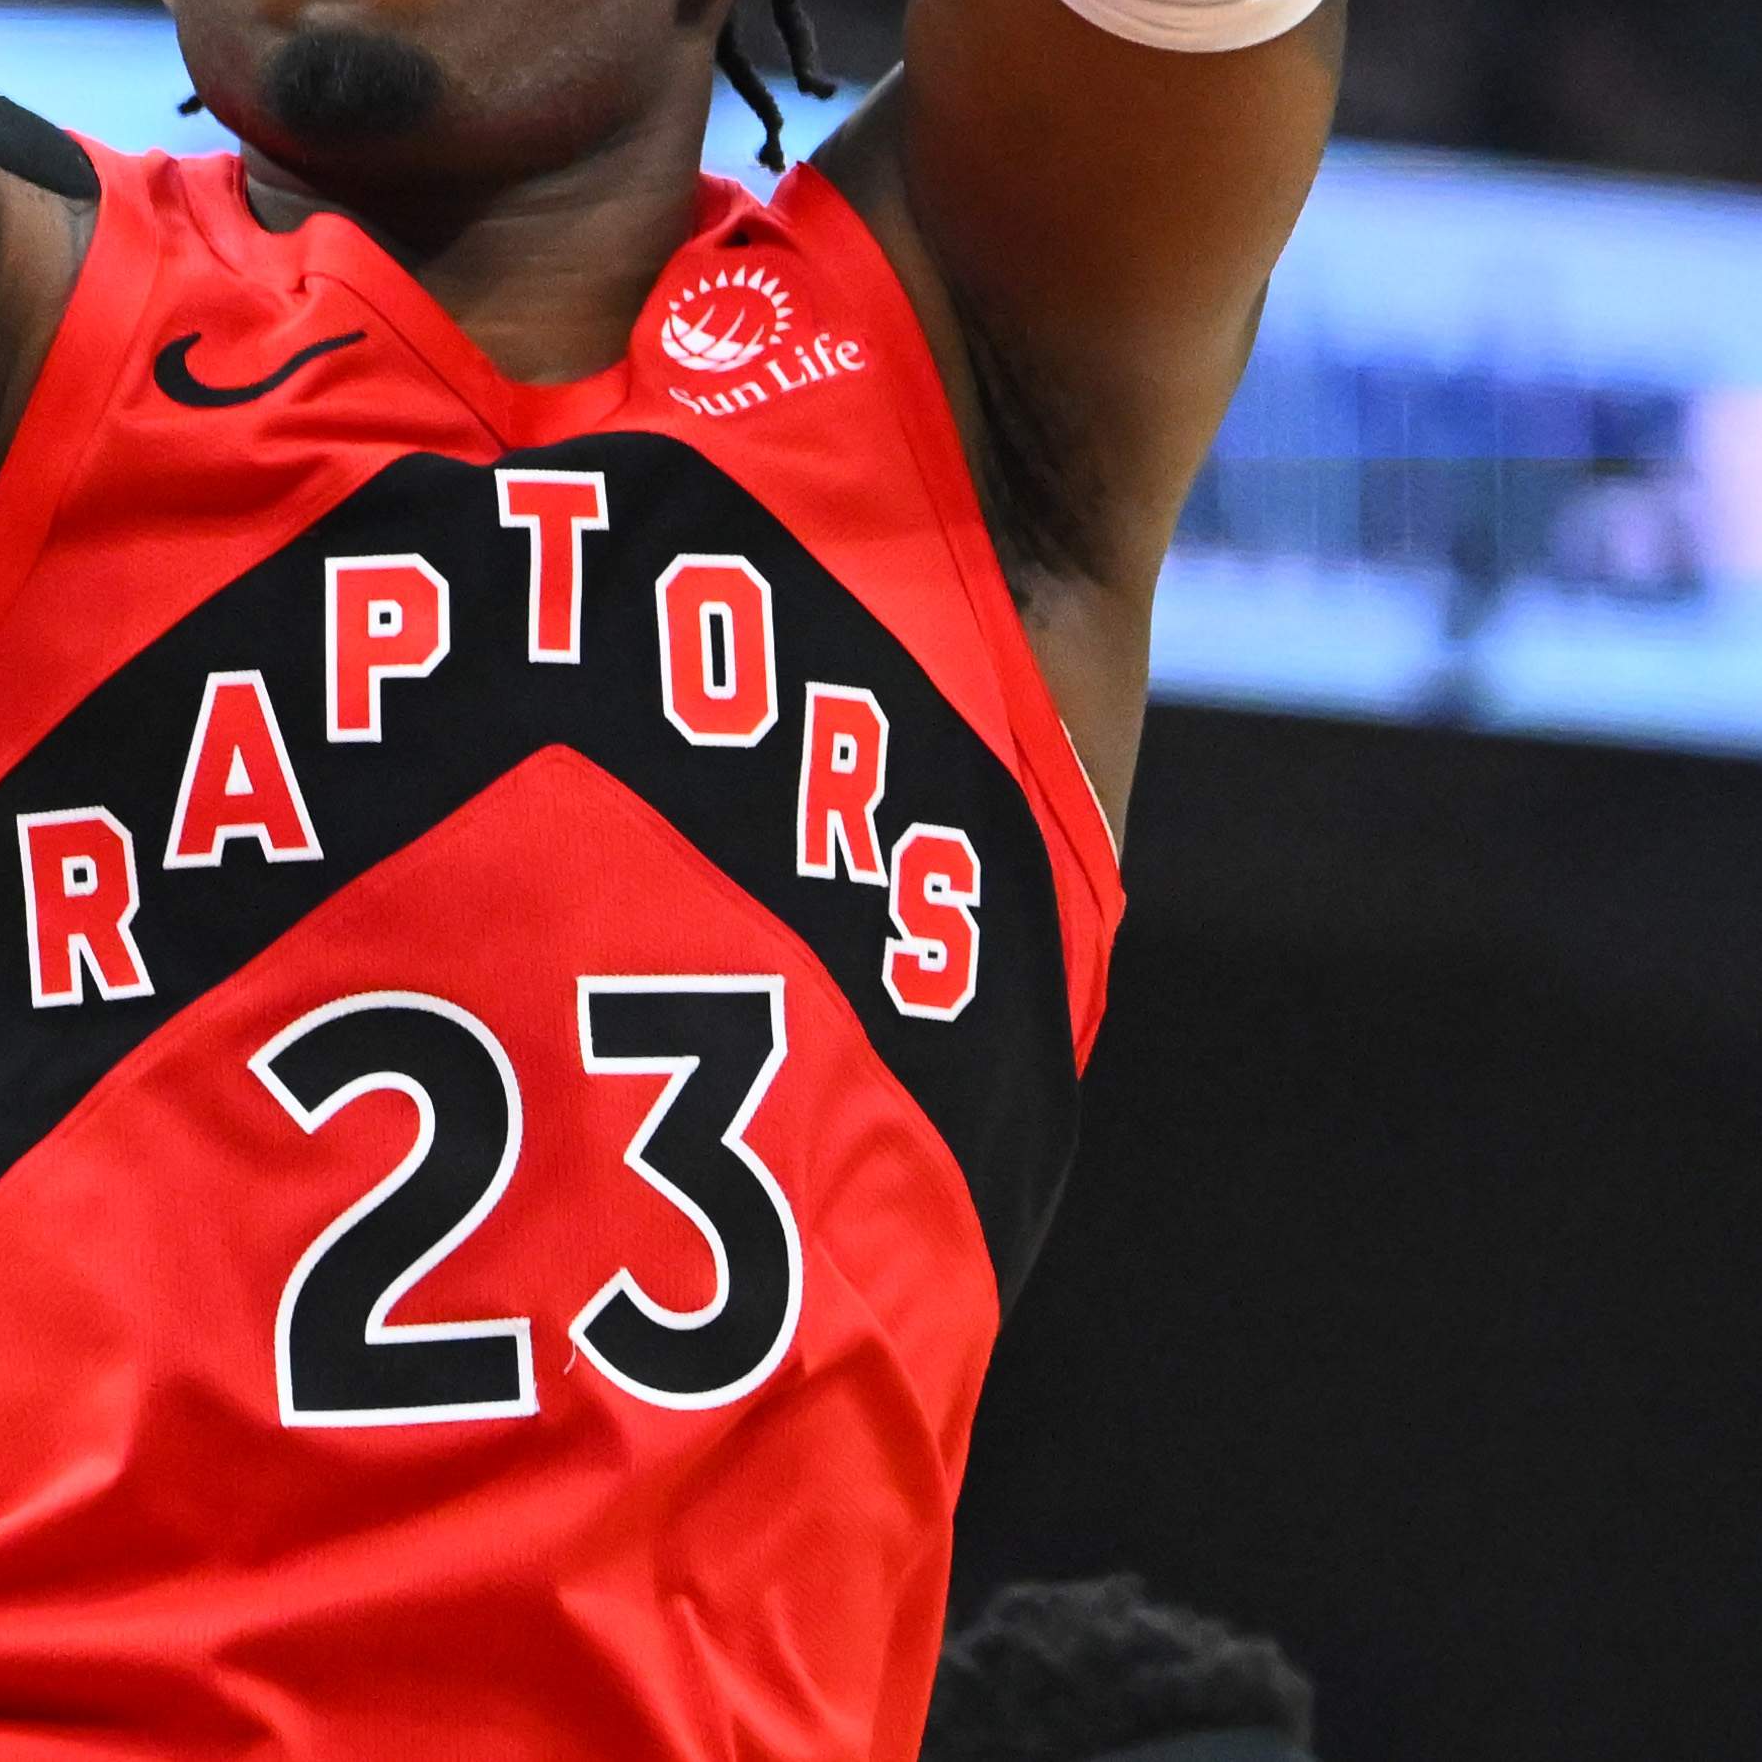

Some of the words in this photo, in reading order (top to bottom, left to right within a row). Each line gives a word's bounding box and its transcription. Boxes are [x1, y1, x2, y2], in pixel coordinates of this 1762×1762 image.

[668, 380, 769, 417] Sun
[765, 333, 866, 393] Life
[16, 468, 981, 1022] RAPTORS
[248, 975, 803, 1428] 23
